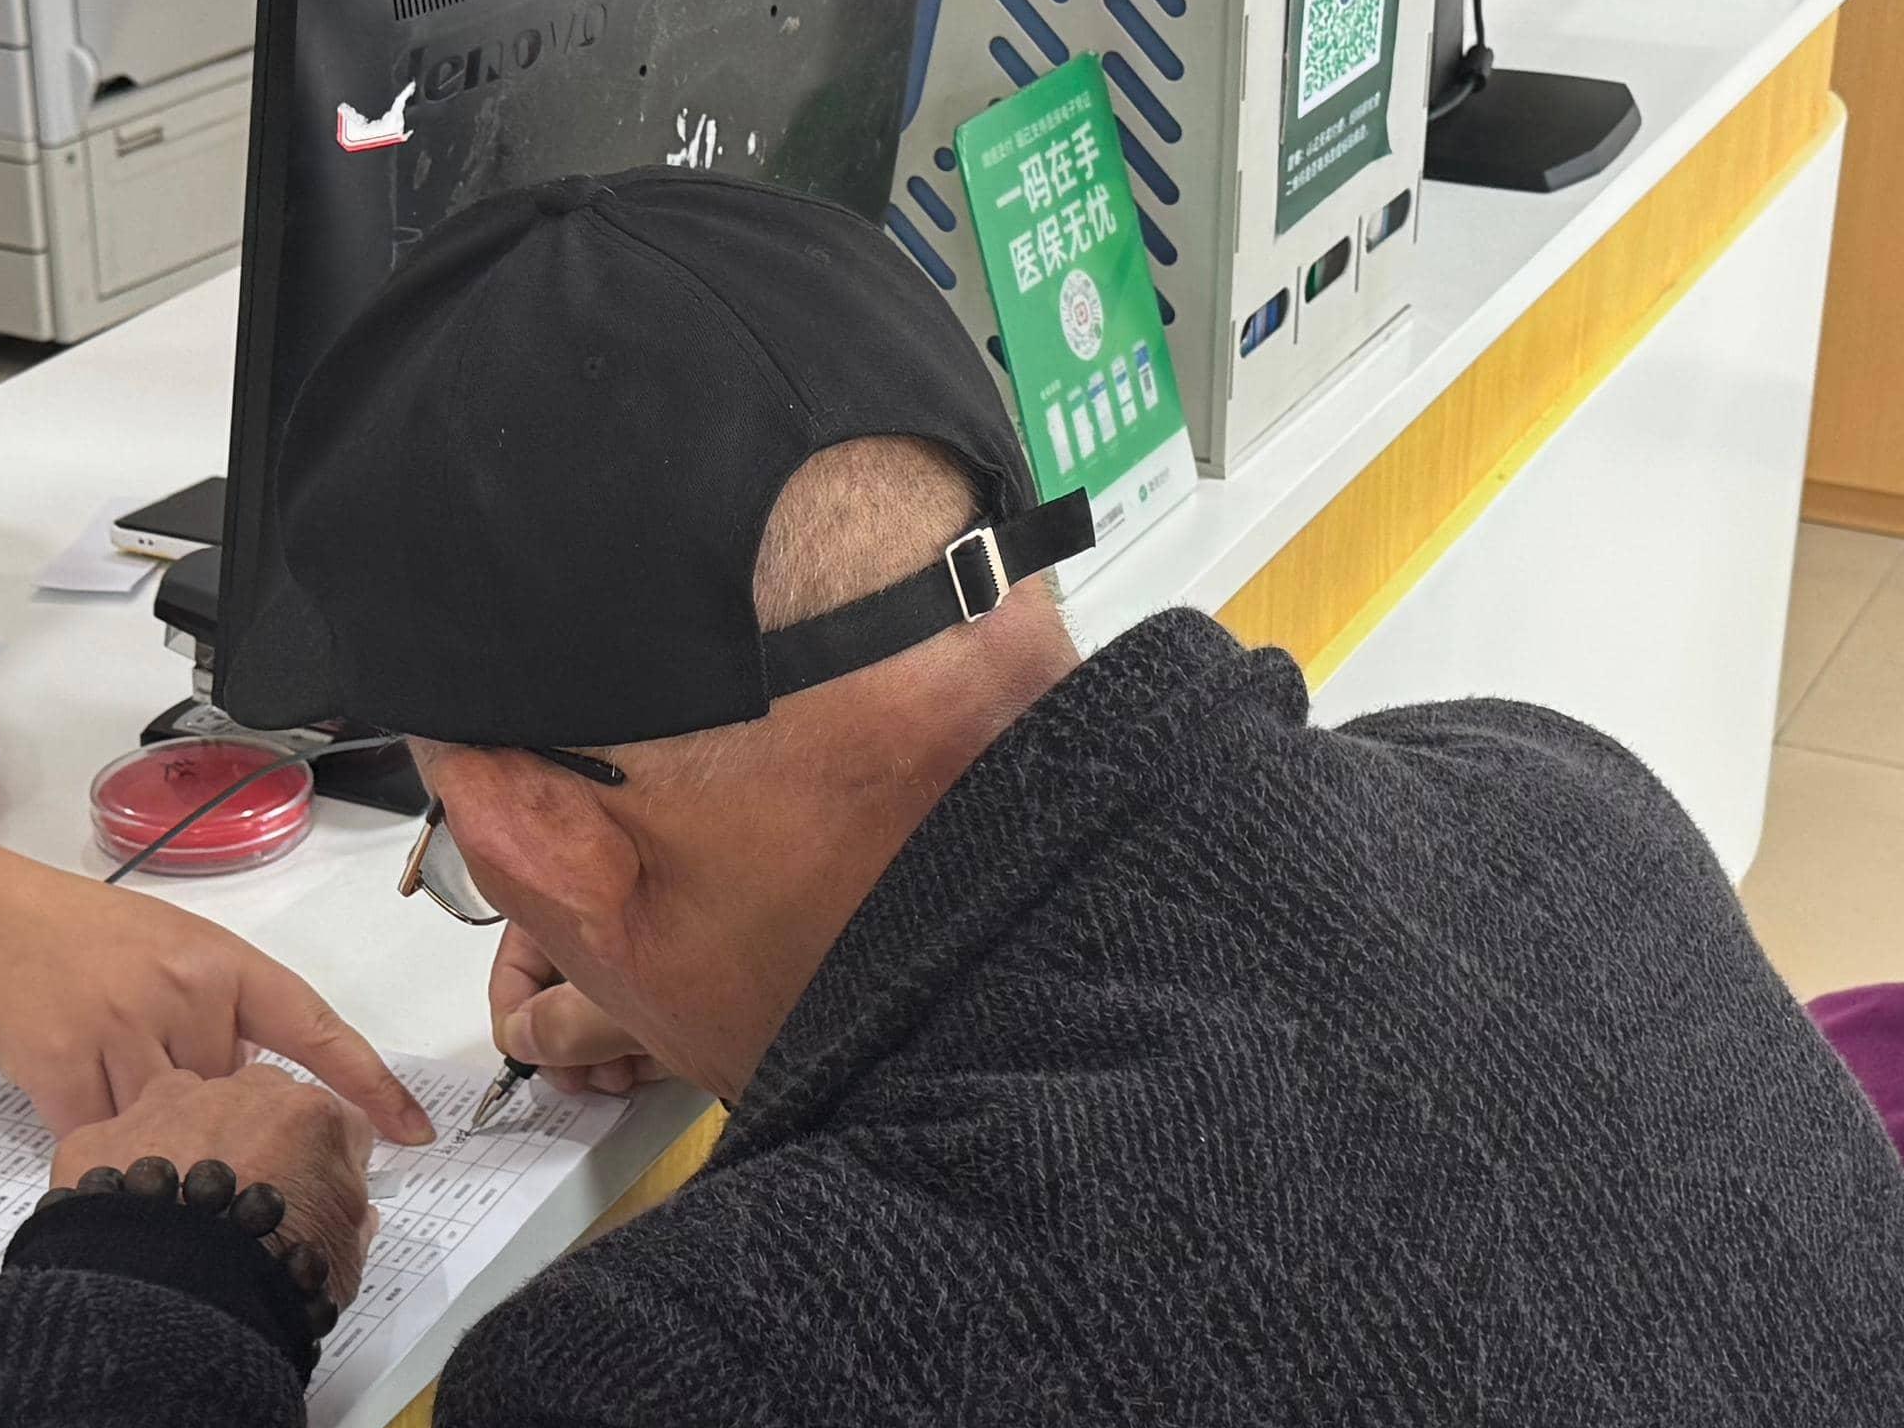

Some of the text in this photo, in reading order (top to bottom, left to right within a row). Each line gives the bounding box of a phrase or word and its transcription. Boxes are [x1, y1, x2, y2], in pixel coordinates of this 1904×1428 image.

[996, 120, 1100, 215] 一码在手
[1008, 188, 1117, 294] 医保无忧
